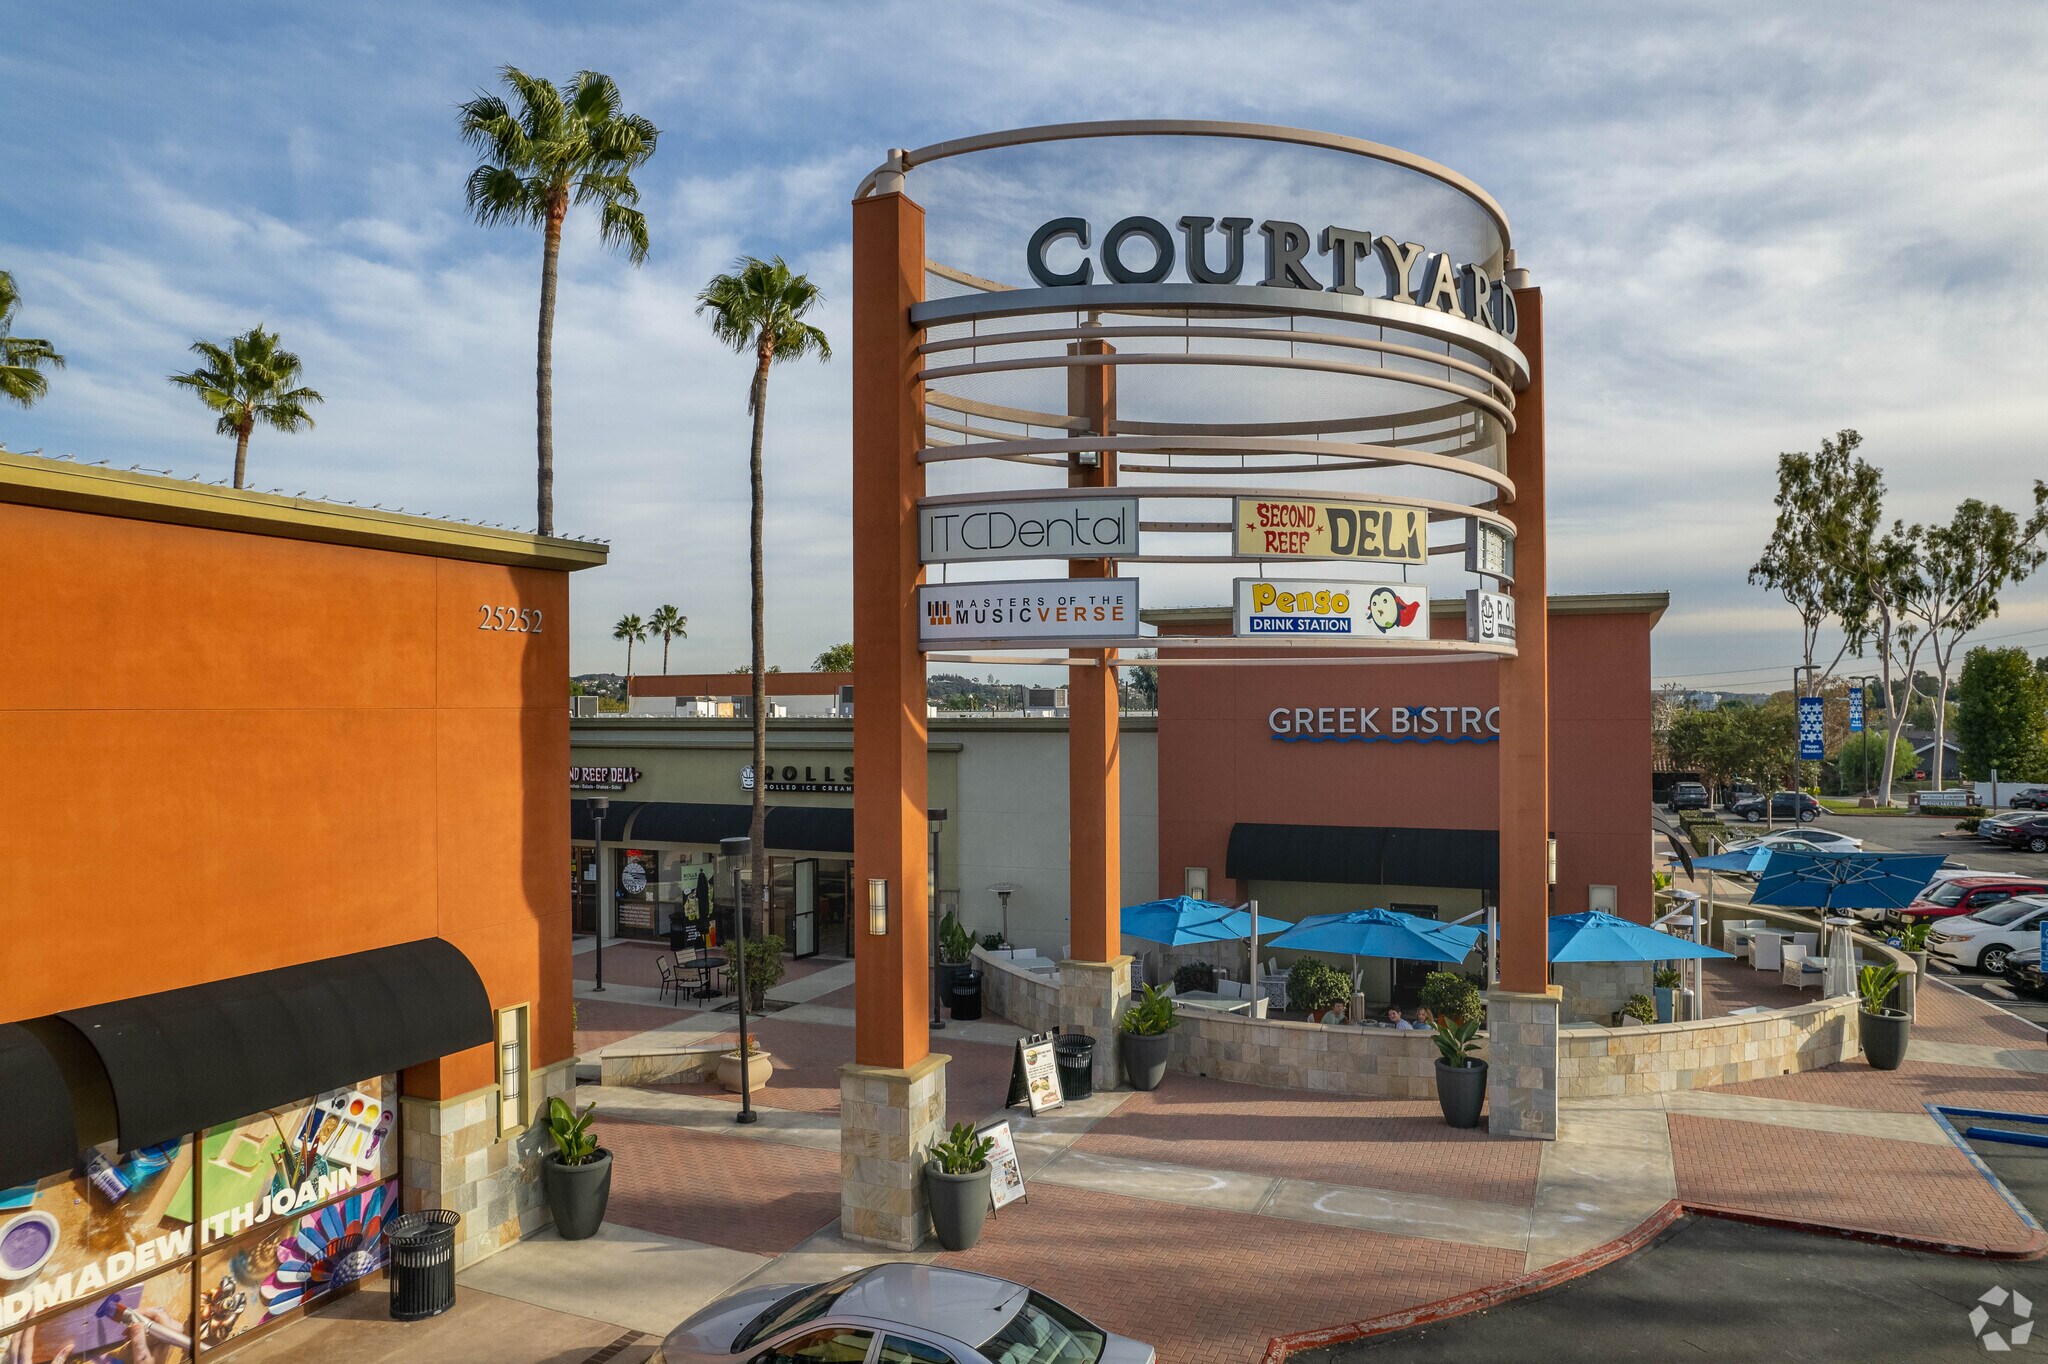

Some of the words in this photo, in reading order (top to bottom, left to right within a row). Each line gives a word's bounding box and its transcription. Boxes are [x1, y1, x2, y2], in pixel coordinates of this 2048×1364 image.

[1026, 215, 1518, 344] COURTYARD
[1256, 503, 1316, 528] SECOND
[930, 507, 1125, 552] ITCDental
[1263, 530, 1310, 554] REEF
[955, 596, 1045, 609] MASTERS
[1058, 596, 1076, 606] OF
[1089, 595, 1124, 605] THE
[1252, 583, 1350, 615] Pengo
[479, 604, 543, 633] 25252
[955, 606, 1125, 625] MUSICVERSE
[1253, 619, 1295, 632] DRINK
[1299, 618, 1349, 631] STATION
[1268, 707, 1380, 733] GREEK
[582, 767, 608, 782] REEF
[764, 765, 855, 783] ROLLS
[0, 1164, 357, 1330] DMADEWITHJOANN
